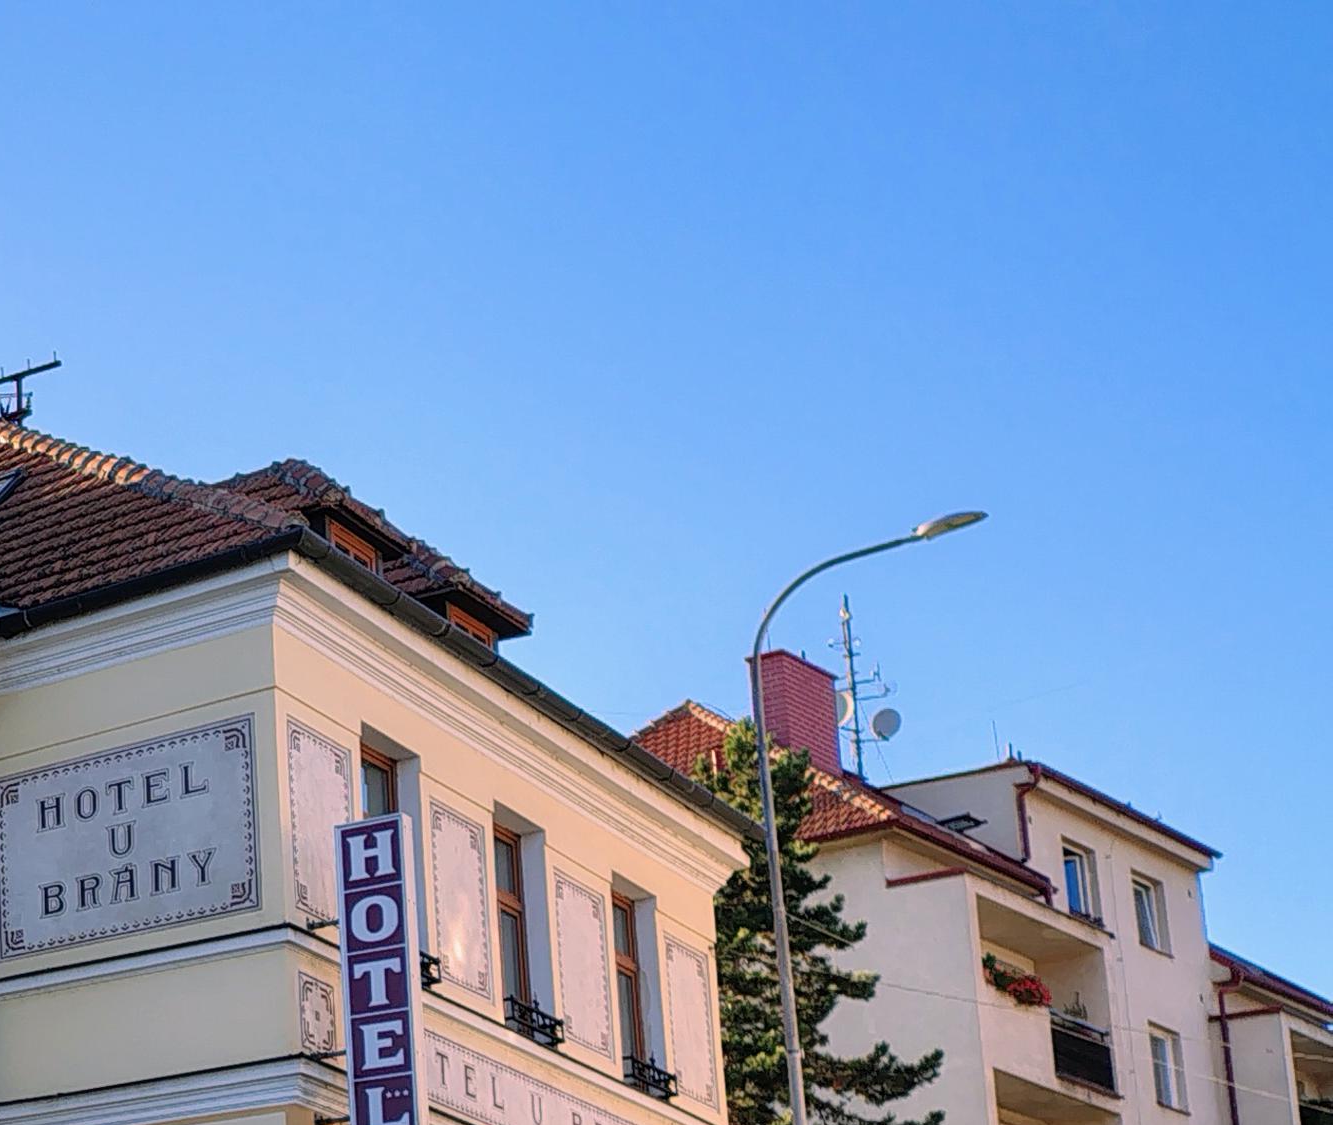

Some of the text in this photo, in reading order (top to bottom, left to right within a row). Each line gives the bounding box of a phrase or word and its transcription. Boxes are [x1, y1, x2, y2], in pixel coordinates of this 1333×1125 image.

[37, 761, 209, 833] HOTEL
[106, 821, 136, 858] U
[436, 1051, 505, 1112] TEL
[531, 1092, 543, 1125] U
